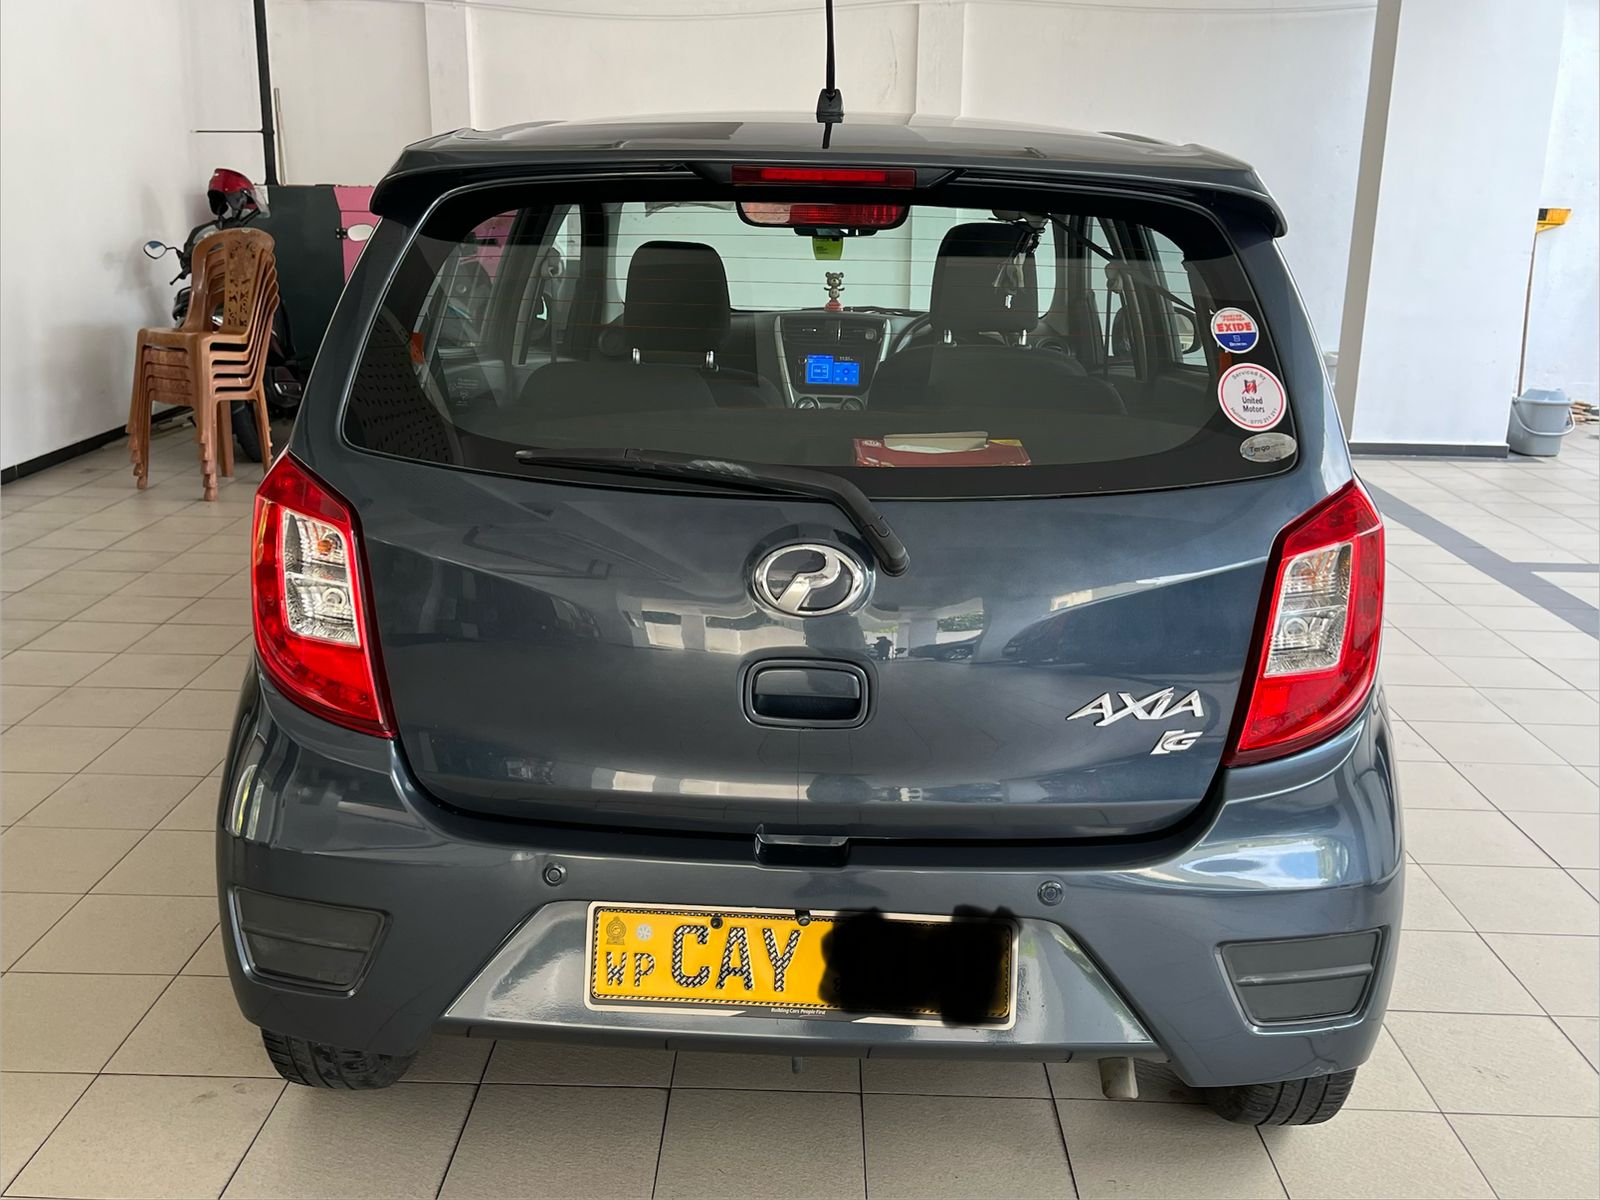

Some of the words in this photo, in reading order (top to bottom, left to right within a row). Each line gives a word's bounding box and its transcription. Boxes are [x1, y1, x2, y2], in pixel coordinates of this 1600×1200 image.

[1216, 322, 1252, 332] EXIDE
[1241, 396, 1263, 405] United
[1242, 405, 1265, 413] Motors
[1066, 687, 1204, 726] AXIA
[606, 951, 656, 987] WP
[672, 924, 801, 993] CAY
